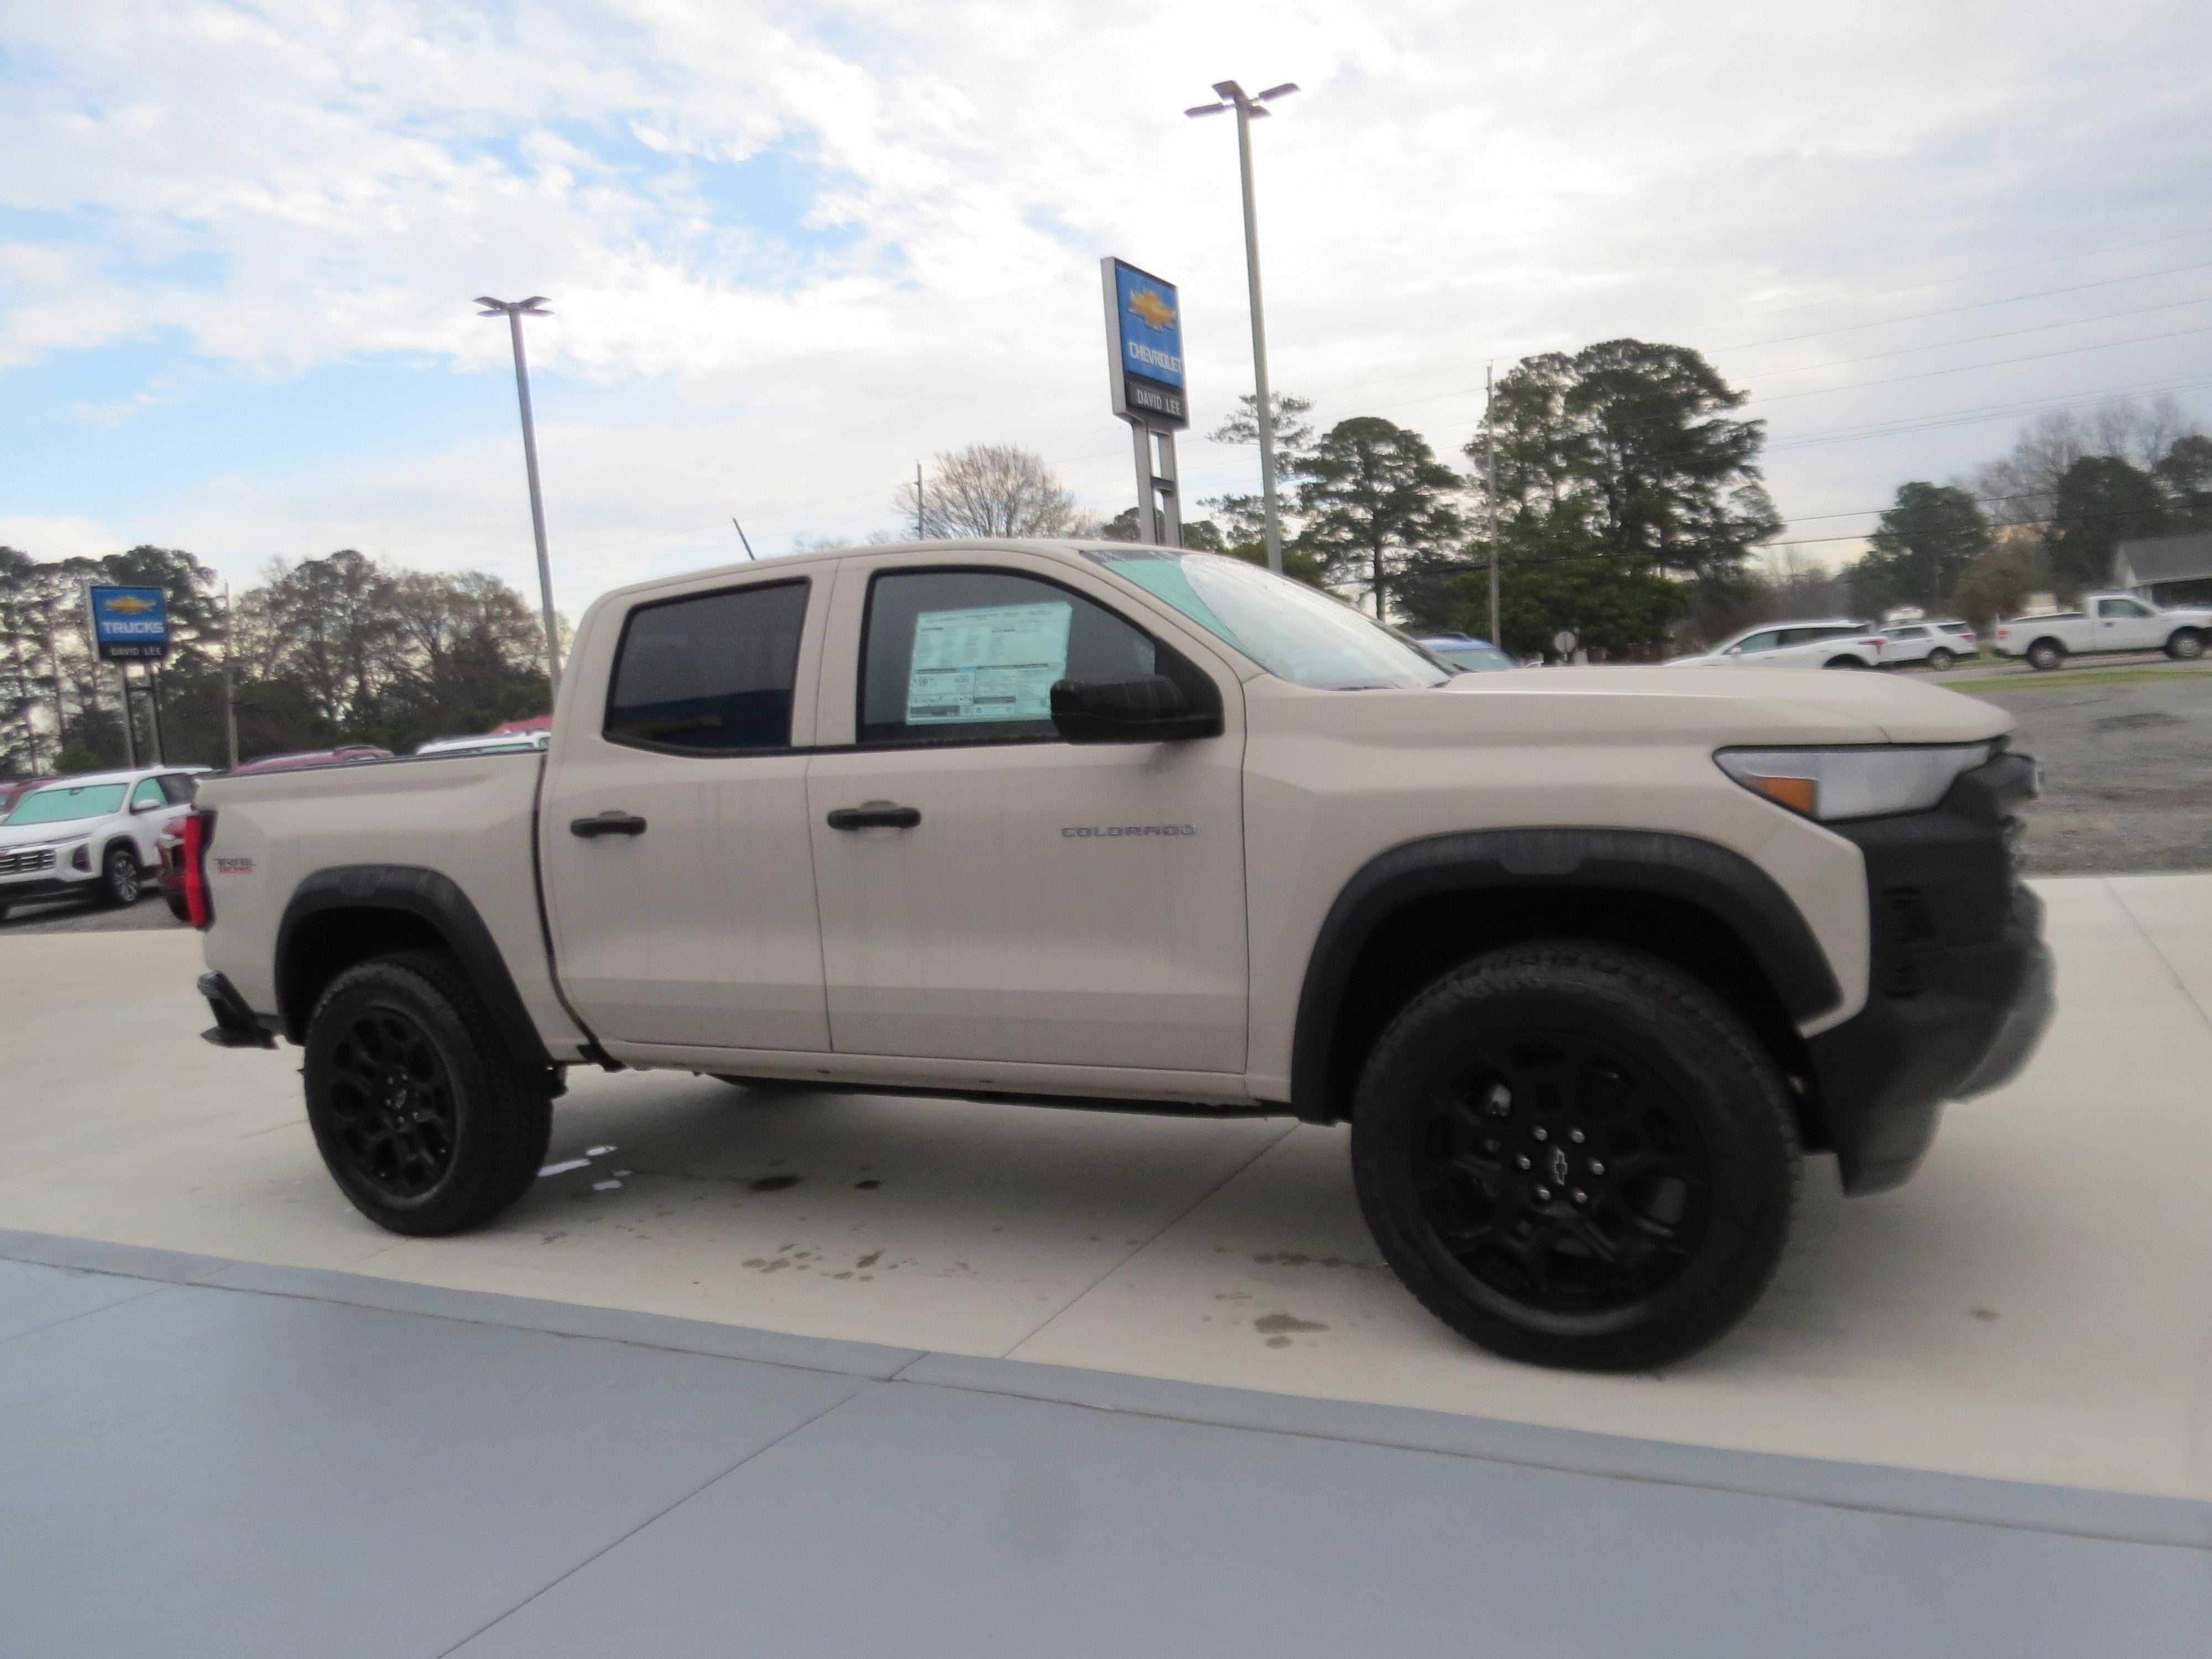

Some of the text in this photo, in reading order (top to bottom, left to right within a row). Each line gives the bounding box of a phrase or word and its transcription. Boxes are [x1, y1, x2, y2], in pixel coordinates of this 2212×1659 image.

[1129, 341, 1182, 374] CHEVROLET
[1138, 389, 1181, 415] DAVID LEE
[103, 622, 164, 634] TRUCKS
[144, 647, 162, 655] LEE
[1061, 824, 1196, 836] COLORADO
